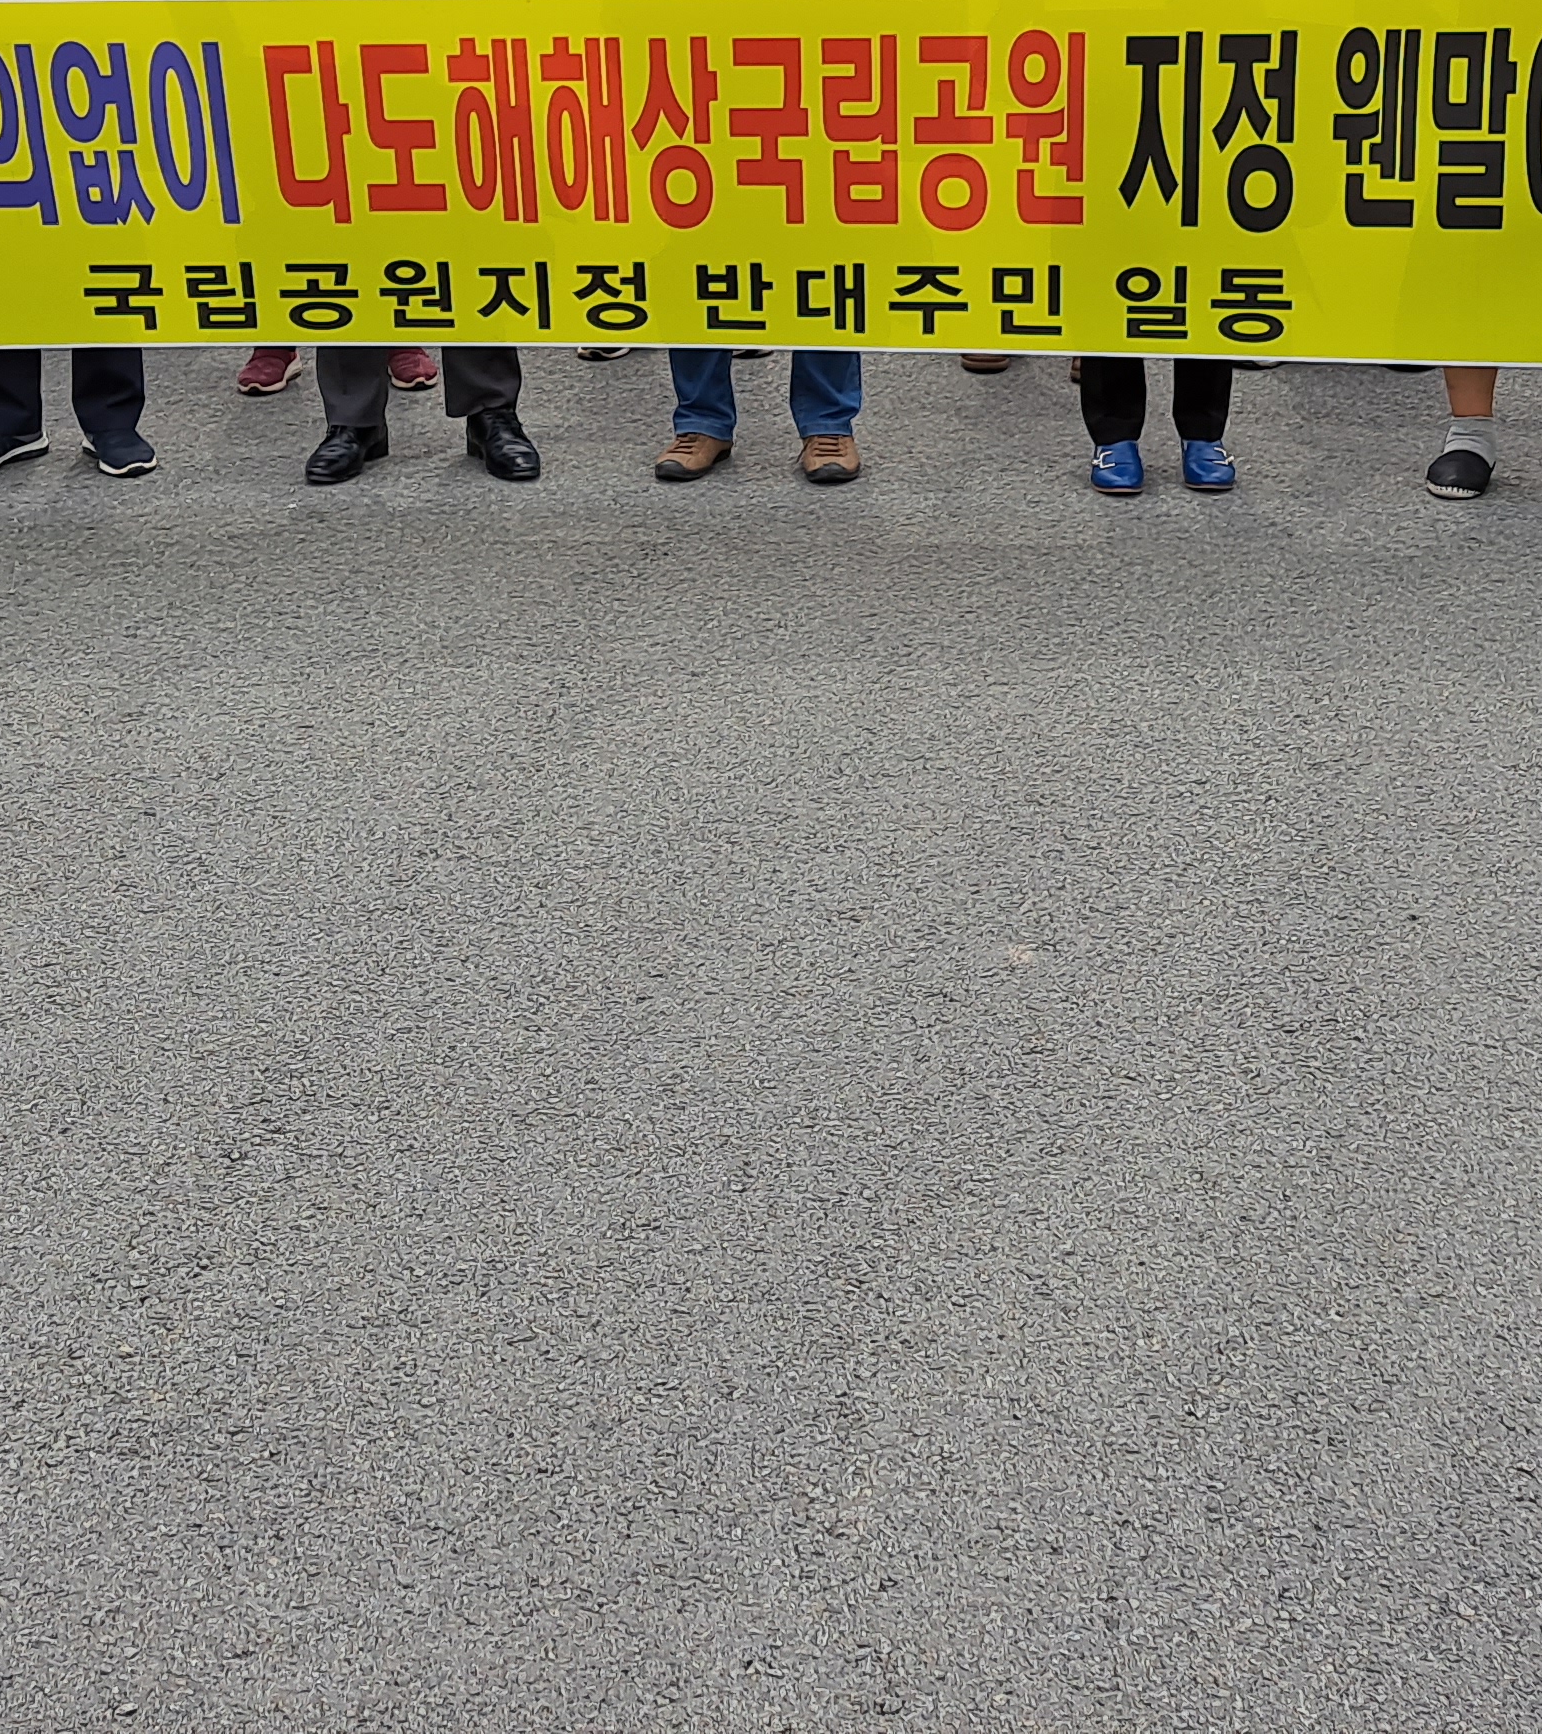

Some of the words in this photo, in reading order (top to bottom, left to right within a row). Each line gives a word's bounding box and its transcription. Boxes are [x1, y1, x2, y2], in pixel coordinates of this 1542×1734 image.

[262, 28, 1089, 232] 다도해해상국립공원
[1118, 30, 1298, 234] 지정
[84, 258, 650, 334] 국립공원지정
[694, 260, 1063, 337] 반대주민
[1115, 263, 1294, 342] 일동
